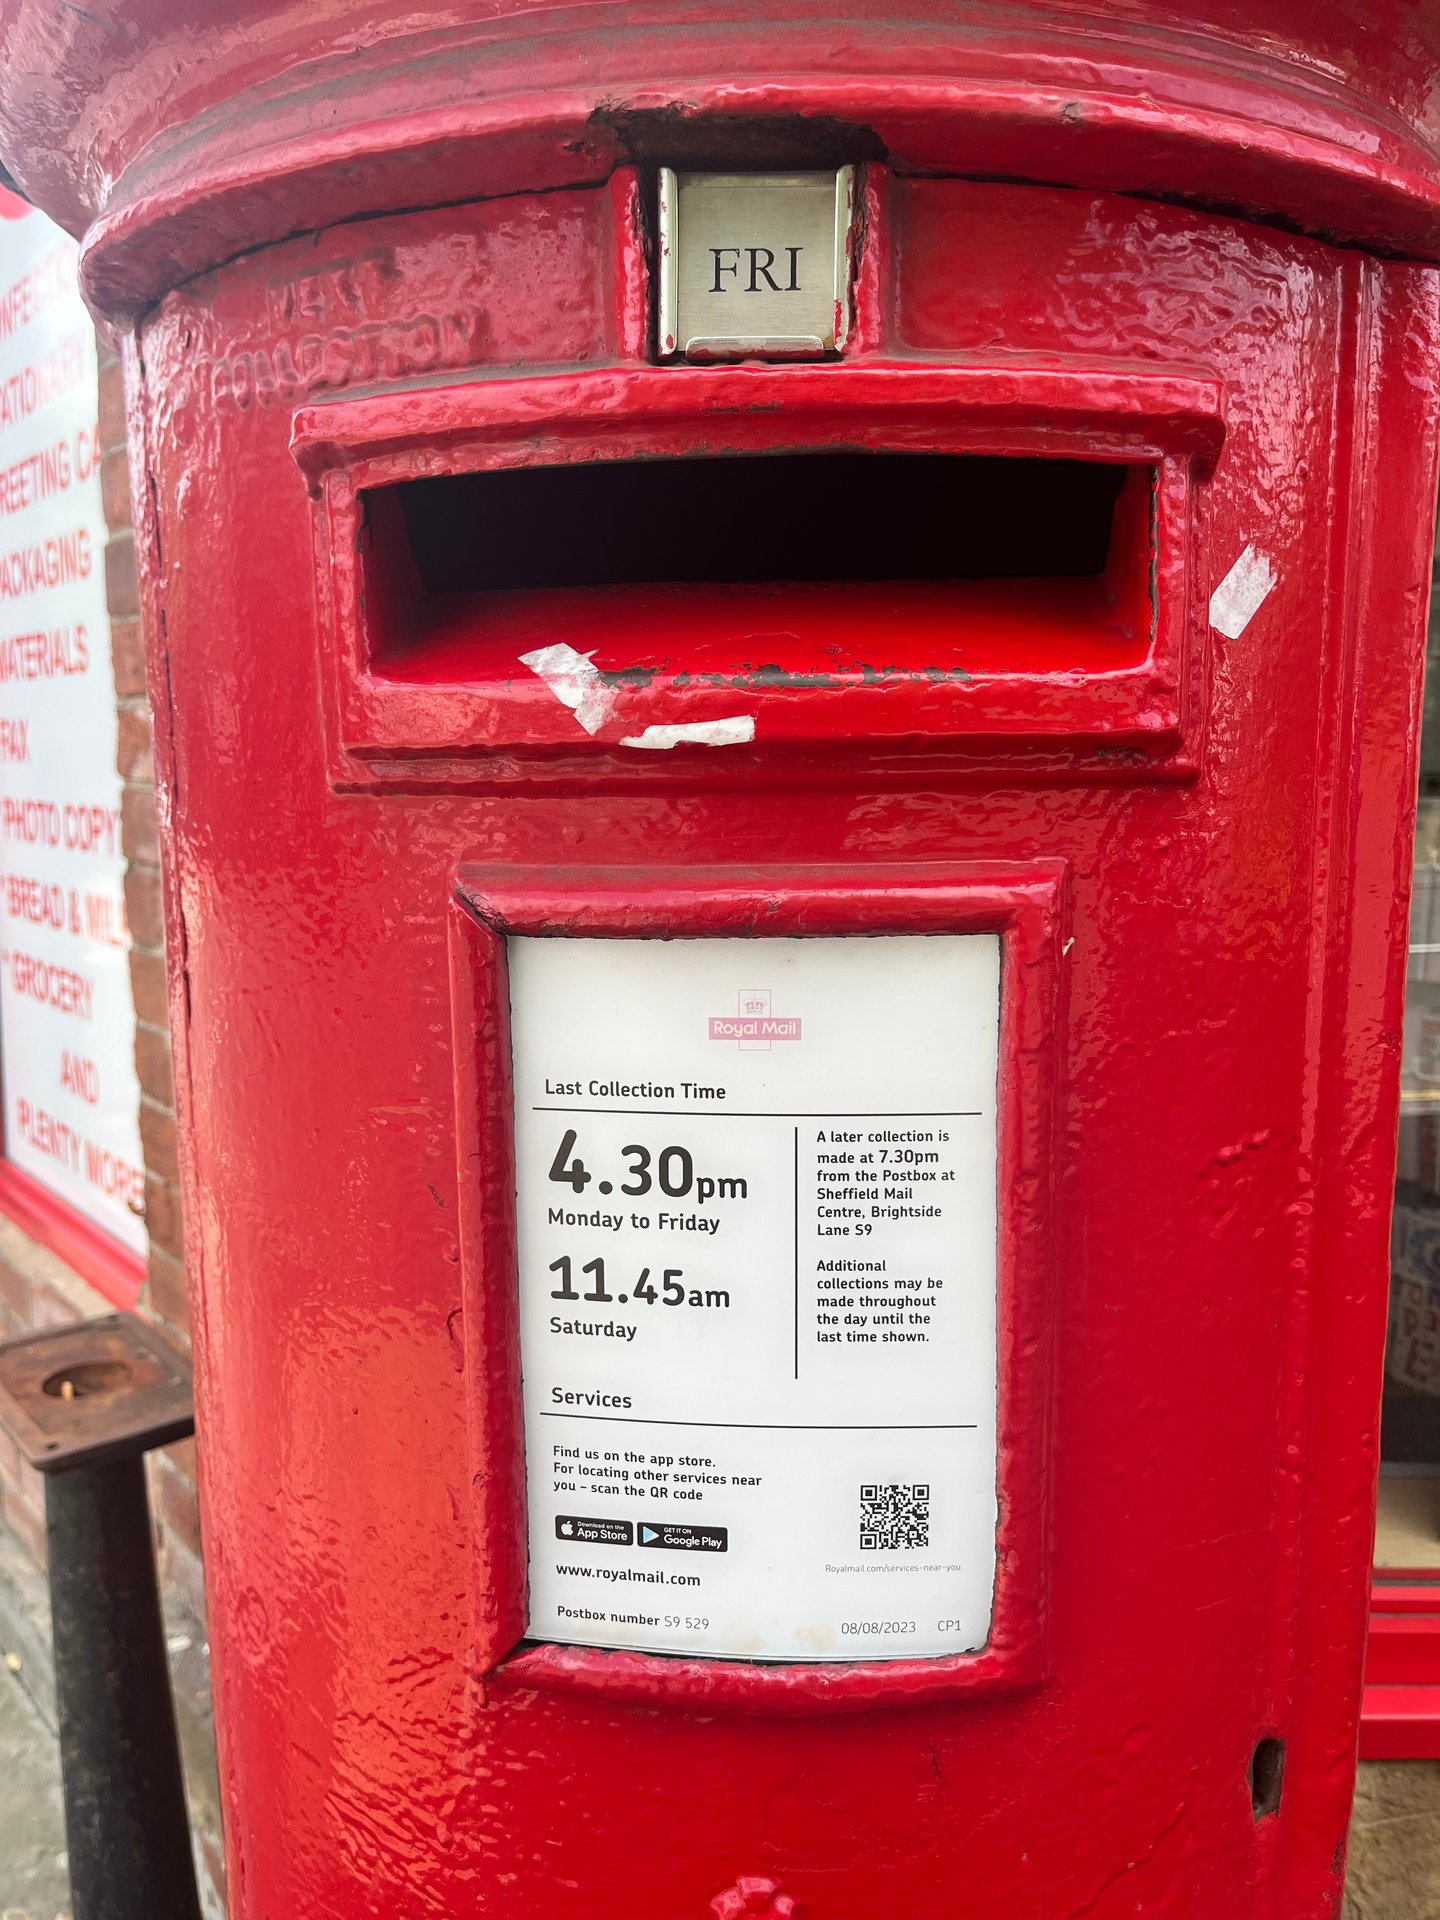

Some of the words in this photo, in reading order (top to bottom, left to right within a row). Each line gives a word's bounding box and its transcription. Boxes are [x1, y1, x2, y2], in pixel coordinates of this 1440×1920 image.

[708, 247, 804, 293] FRI
[0, 718, 30, 764] FAX
[3, 798, 60, 847] PHOTO
[64, 805, 119, 854] COPY
[8, 874, 64, 930] BREAD
[69, 888, 82, 936] &
[12, 950, 93, 1021] GROCERY
[713, 1020, 758, 1038] Royal
[762, 1021, 796, 1035] Mail
[60, 1050, 99, 1105] AND
[545, 1078, 583, 1096] Last
[588, 1079, 675, 1099] Collection
[680, 1083, 727, 1100] Time
[816, 1130, 827, 1143] A
[830, 1130, 864, 1143] later
[867, 1129, 934, 1143] collection
[938, 1129, 950, 1142] is
[17, 1097, 80, 1172] PLENTY
[84, 1140, 144, 1198] MORE
[816, 1151, 855, 1164] made
[859, 1152, 875, 1164] at
[878, 1149, 939, 1167] 7.30pm
[548, 1128, 748, 1205] 4.30pm
[816, 1169, 850, 1182] from
[854, 1169, 878, 1182] the
[882, 1169, 937, 1182] Postbox
[940, 1169, 956, 1182] at
[816, 1187, 879, 1200] Sheffield
[884, 1186, 913, 1200] Mail
[548, 1207, 624, 1232] Monday
[630, 1212, 651, 1231] to
[658, 1212, 721, 1236] Friday
[817, 1205, 866, 1220] Centre,
[871, 1204, 942, 1221] Brightside
[817, 1223, 850, 1236] Lane
[855, 1223, 873, 1236] S9
[816, 1259, 887, 1272] Additional
[548, 1255, 730, 1308] 11.45am
[816, 1276, 890, 1290] collections
[894, 1280, 923, 1293] may
[926, 1276, 944, 1289] be
[816, 1295, 855, 1308] made
[858, 1294, 937, 1310] throughout
[549, 1316, 638, 1343] Saturday
[816, 1312, 839, 1325] the
[843, 1312, 868, 1328] day
[872, 1312, 904, 1325] until
[908, 1312, 931, 1325] the
[816, 1330, 843, 1343] last
[846, 1330, 878, 1343] time
[881, 1330, 930, 1343] shown.
[551, 1386, 633, 1409] Services
[553, 1444, 580, 1459] Find
[584, 1450, 600, 1461] us
[603, 1451, 620, 1463] on
[623, 1451, 646, 1464] the
[649, 1455, 674, 1469] app
[678, 1455, 716, 1468] store.
[553, 1461, 575, 1475] For
[578, 1463, 629, 1482] locating
[633, 1467, 668, 1482] other
[673, 1471, 727, 1486] services
[731, 1474, 763, 1486] near
[553, 1479, 577, 1494] you
[590, 1484, 620, 1496] scan
[624, 1484, 646, 1498] the
[649, 1486, 669, 1499] QR
[673, 1488, 704, 1501] code
[577, 1520, 605, 1530] Download
[615, 1523, 625, 1531] the
[577, 1527, 599, 1540] App
[600, 1529, 628, 1541] Store
[663, 1533, 700, 1548] Google
[701, 1536, 723, 1549] Play
[555, 1564, 701, 1588] www.royalmail.com
[825, 1563, 961, 1574] Royalmail.com/services-near-you
[557, 1605, 607, 1622] Postbox
[610, 1610, 661, 1627] number
[664, 1615, 682, 1629] S9
[685, 1617, 710, 1630] 529
[841, 1621, 917, 1635] 08/08/2023
[937, 1619, 962, 1632] CP1
